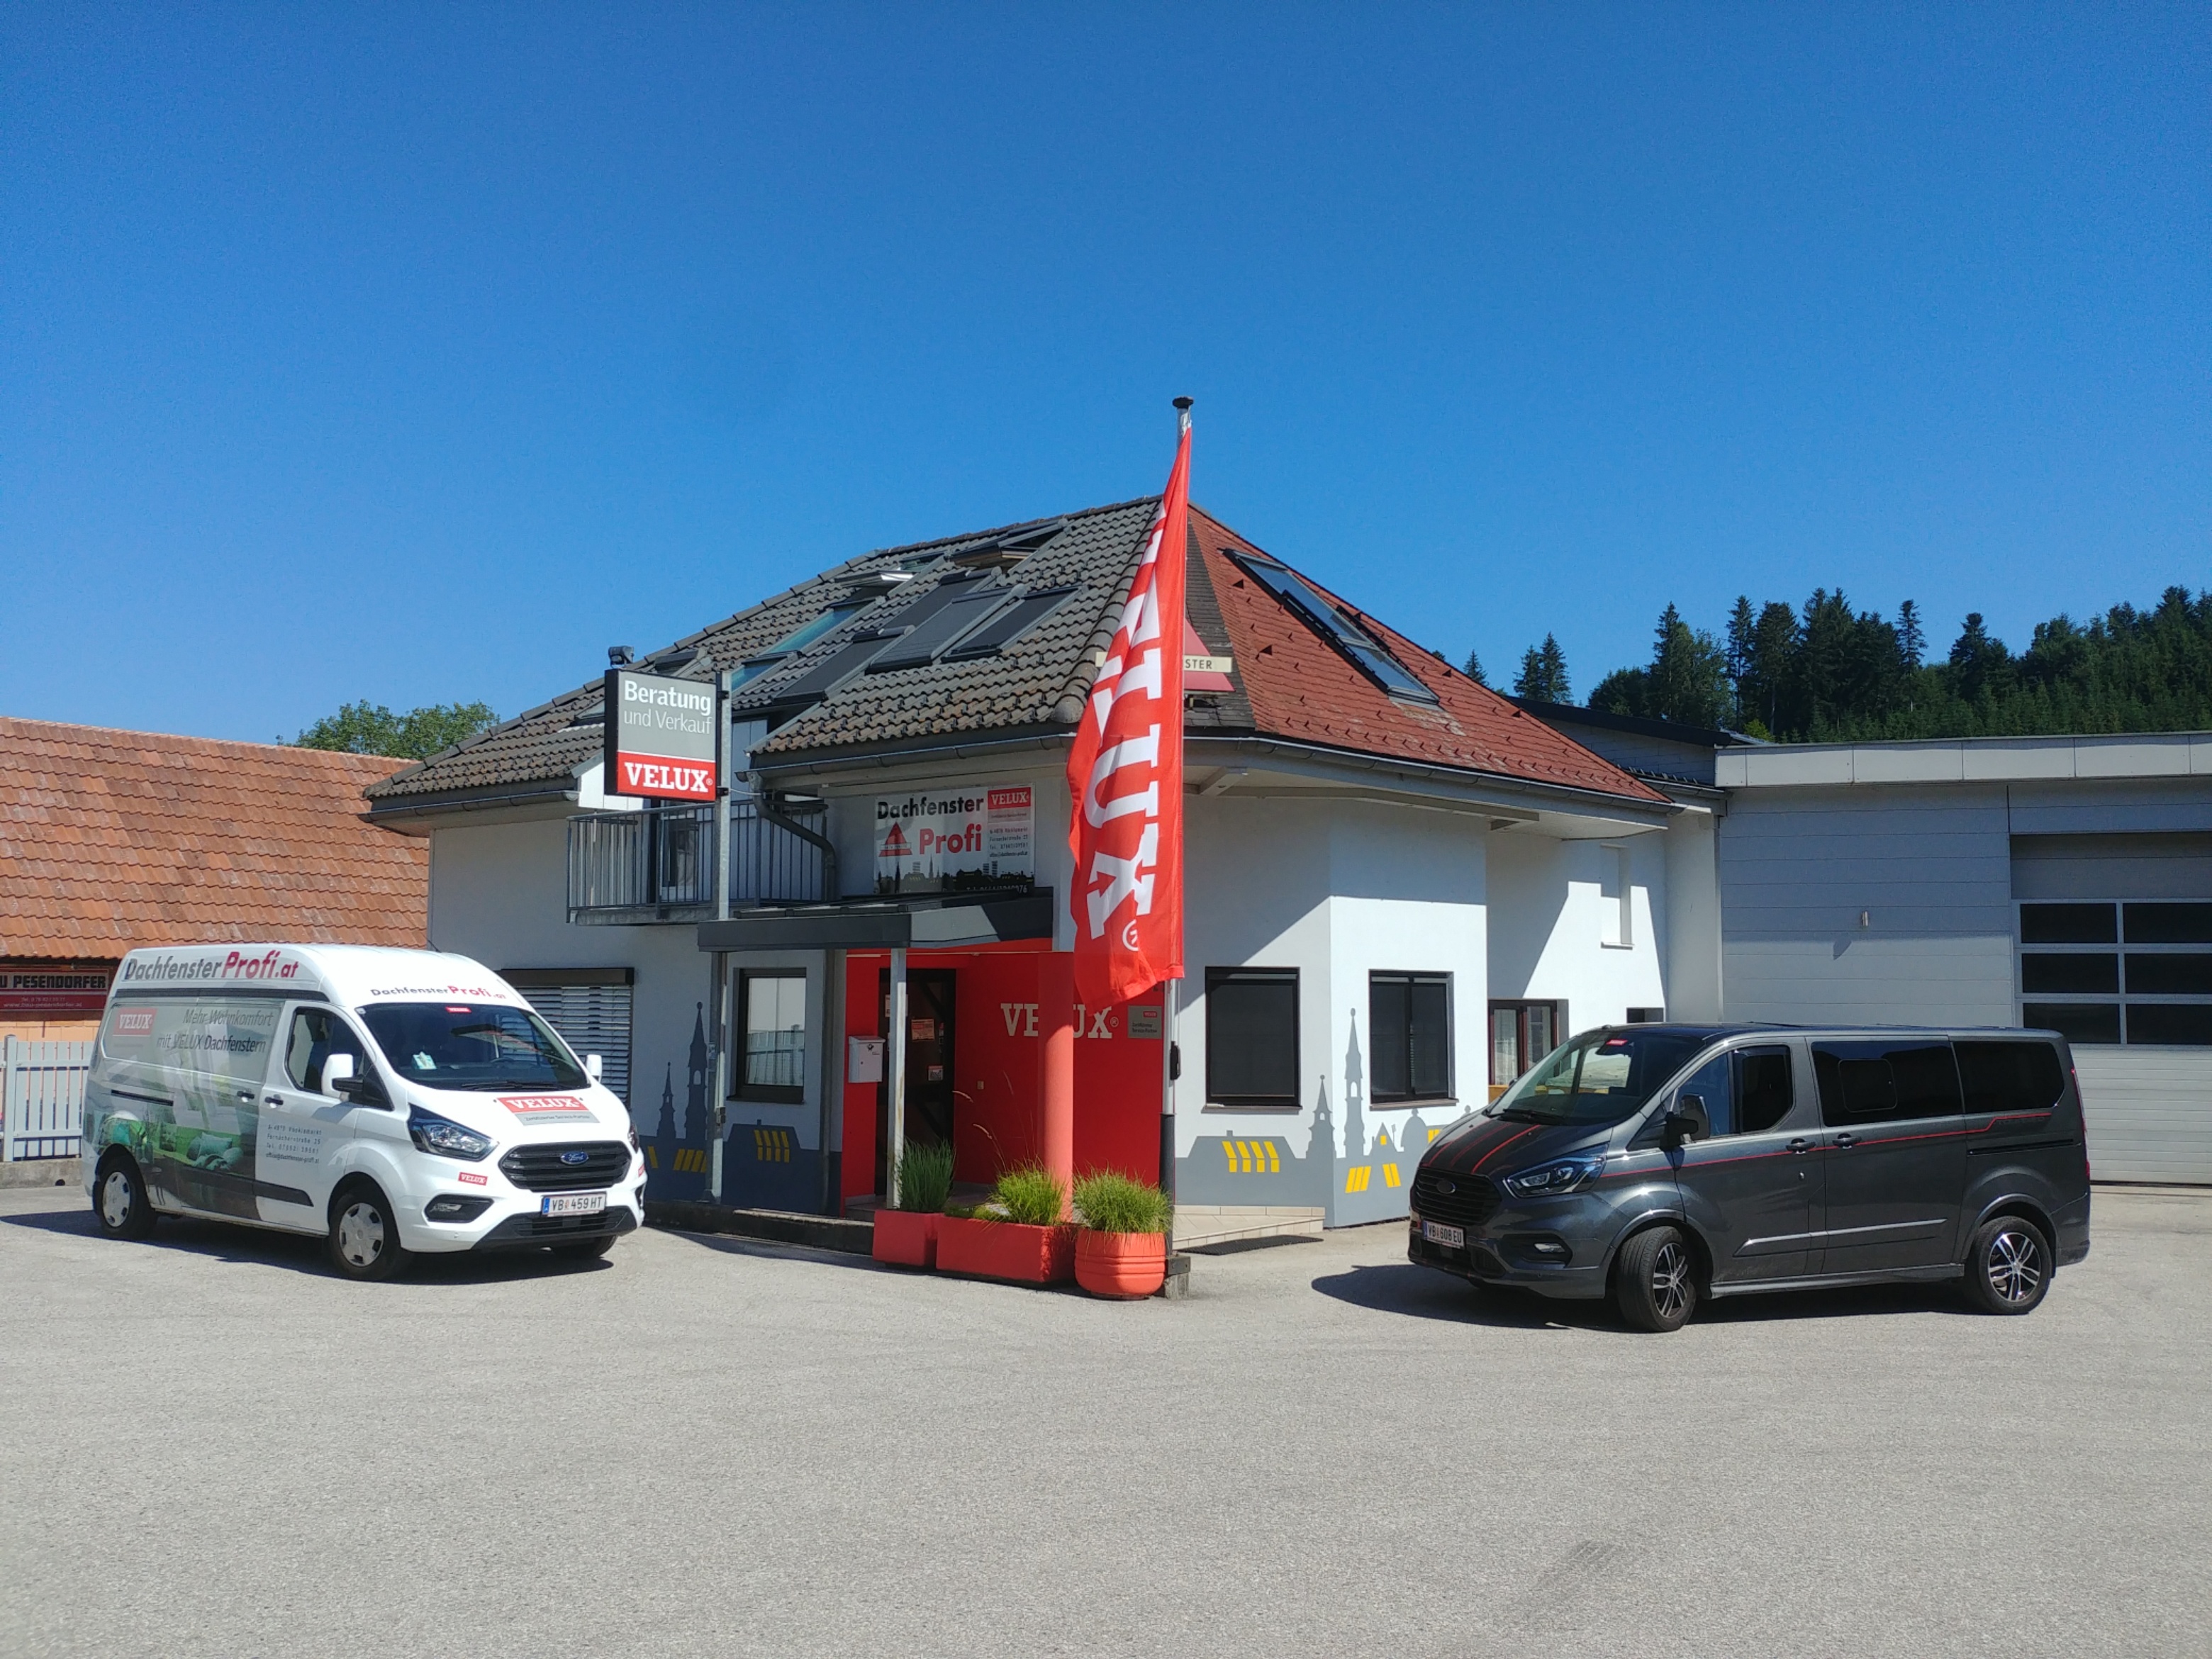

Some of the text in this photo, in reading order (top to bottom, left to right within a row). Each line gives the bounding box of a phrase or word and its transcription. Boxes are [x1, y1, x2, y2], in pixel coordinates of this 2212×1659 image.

[625, 680, 711, 716] Beratung
[624, 709, 713, 734] und Verkauf
[625, 761, 709, 793] VELUX
[878, 796, 984, 820] Dachfenster
[991, 792, 1027, 805] VELUX
[920, 823, 982, 855] Profi
[124, 950, 299, 980] DachfensterProfi.at
[13, 976, 106, 988] PESENDORFER
[118, 1014, 152, 1029] VELUX
[183, 1009, 274, 1026] Mehr Wohnkomfort
[157, 1034, 266, 1053] mit VELUX Dachfenstern
[506, 1098, 577, 1109] VELUX
[461, 1174, 486, 1184] VELUX
